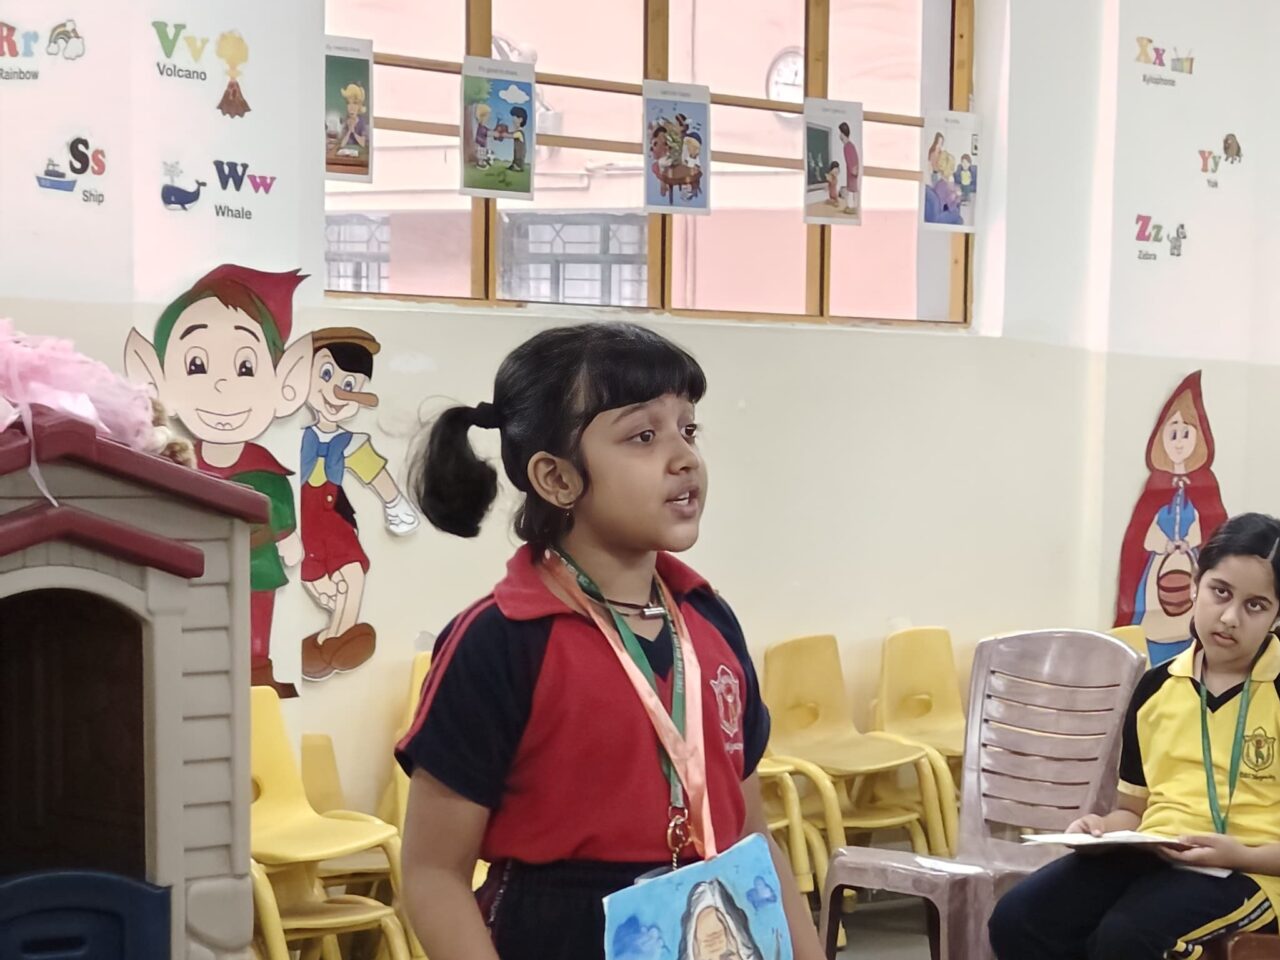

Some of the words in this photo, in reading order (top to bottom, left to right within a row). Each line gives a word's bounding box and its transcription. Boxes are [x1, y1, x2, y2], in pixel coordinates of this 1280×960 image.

[0, 21, 39, 58] Rr
[152, 21, 209, 63] Vv
[1135, 36, 1166, 67] Xx
[0, 68, 39, 80] Rainbow
[157, 62, 207, 81] Volcano
[69, 137, 106, 176] Ss
[1198, 150, 1222, 173] Yy
[213, 160, 277, 194] Ww
[82, 190, 105, 205] Ship
[215, 205, 252, 220] Whale
[1135, 214, 1163, 242] Zz
